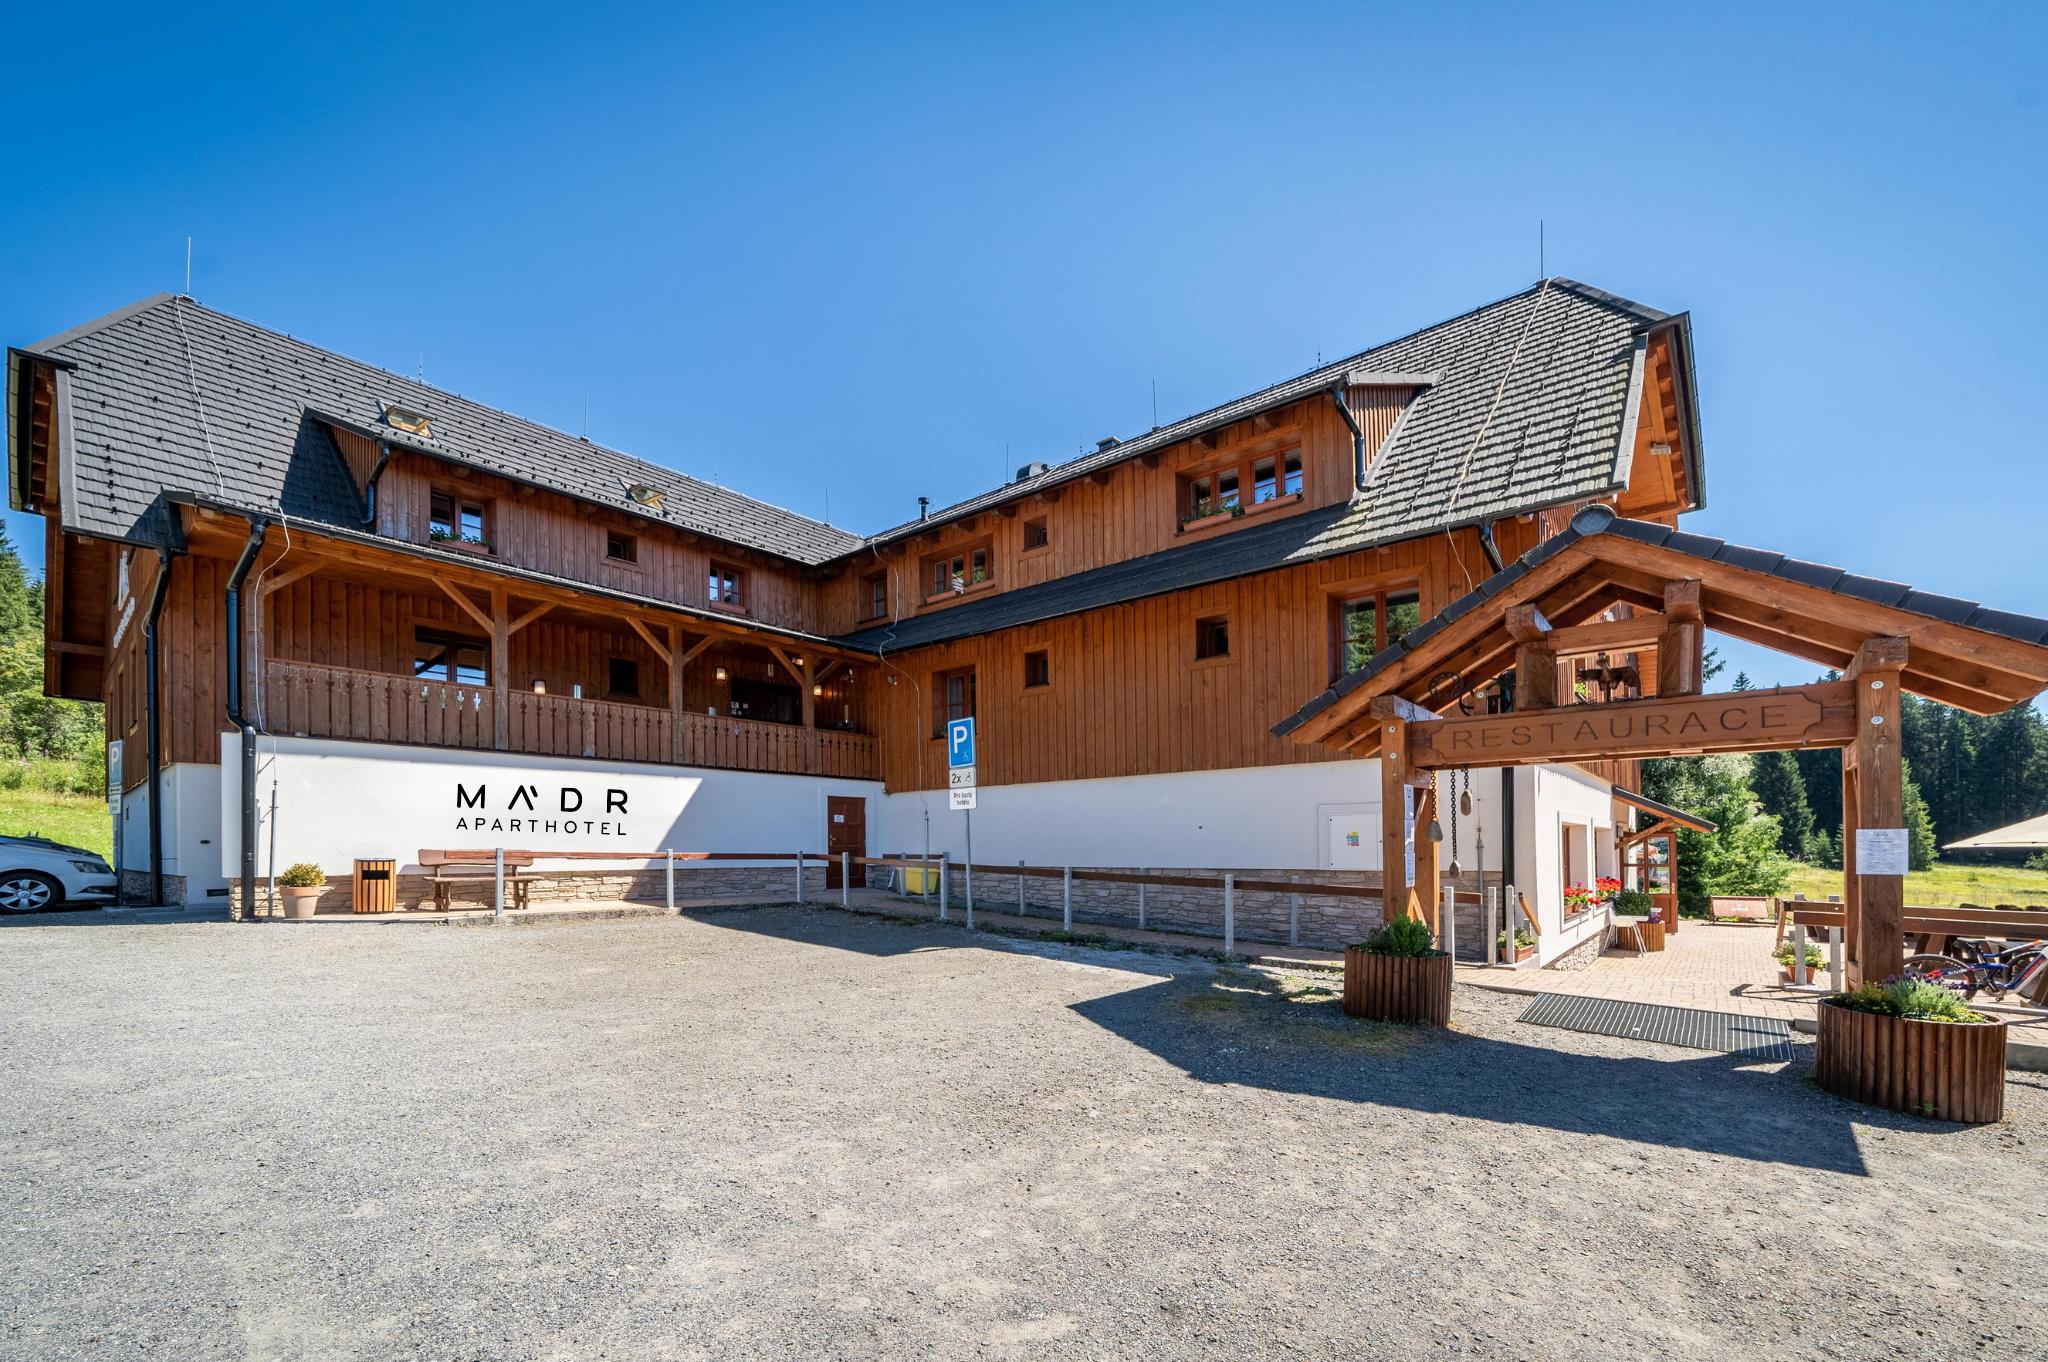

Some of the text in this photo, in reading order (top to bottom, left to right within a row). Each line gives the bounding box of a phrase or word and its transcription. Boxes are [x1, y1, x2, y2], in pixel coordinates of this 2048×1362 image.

[953, 725, 968, 754] P
[1452, 704, 1788, 750] RESTAURACE
[111, 746, 119, 772] P
[951, 773, 962, 784] 2x
[456, 817, 627, 836] APARTHOTEL
